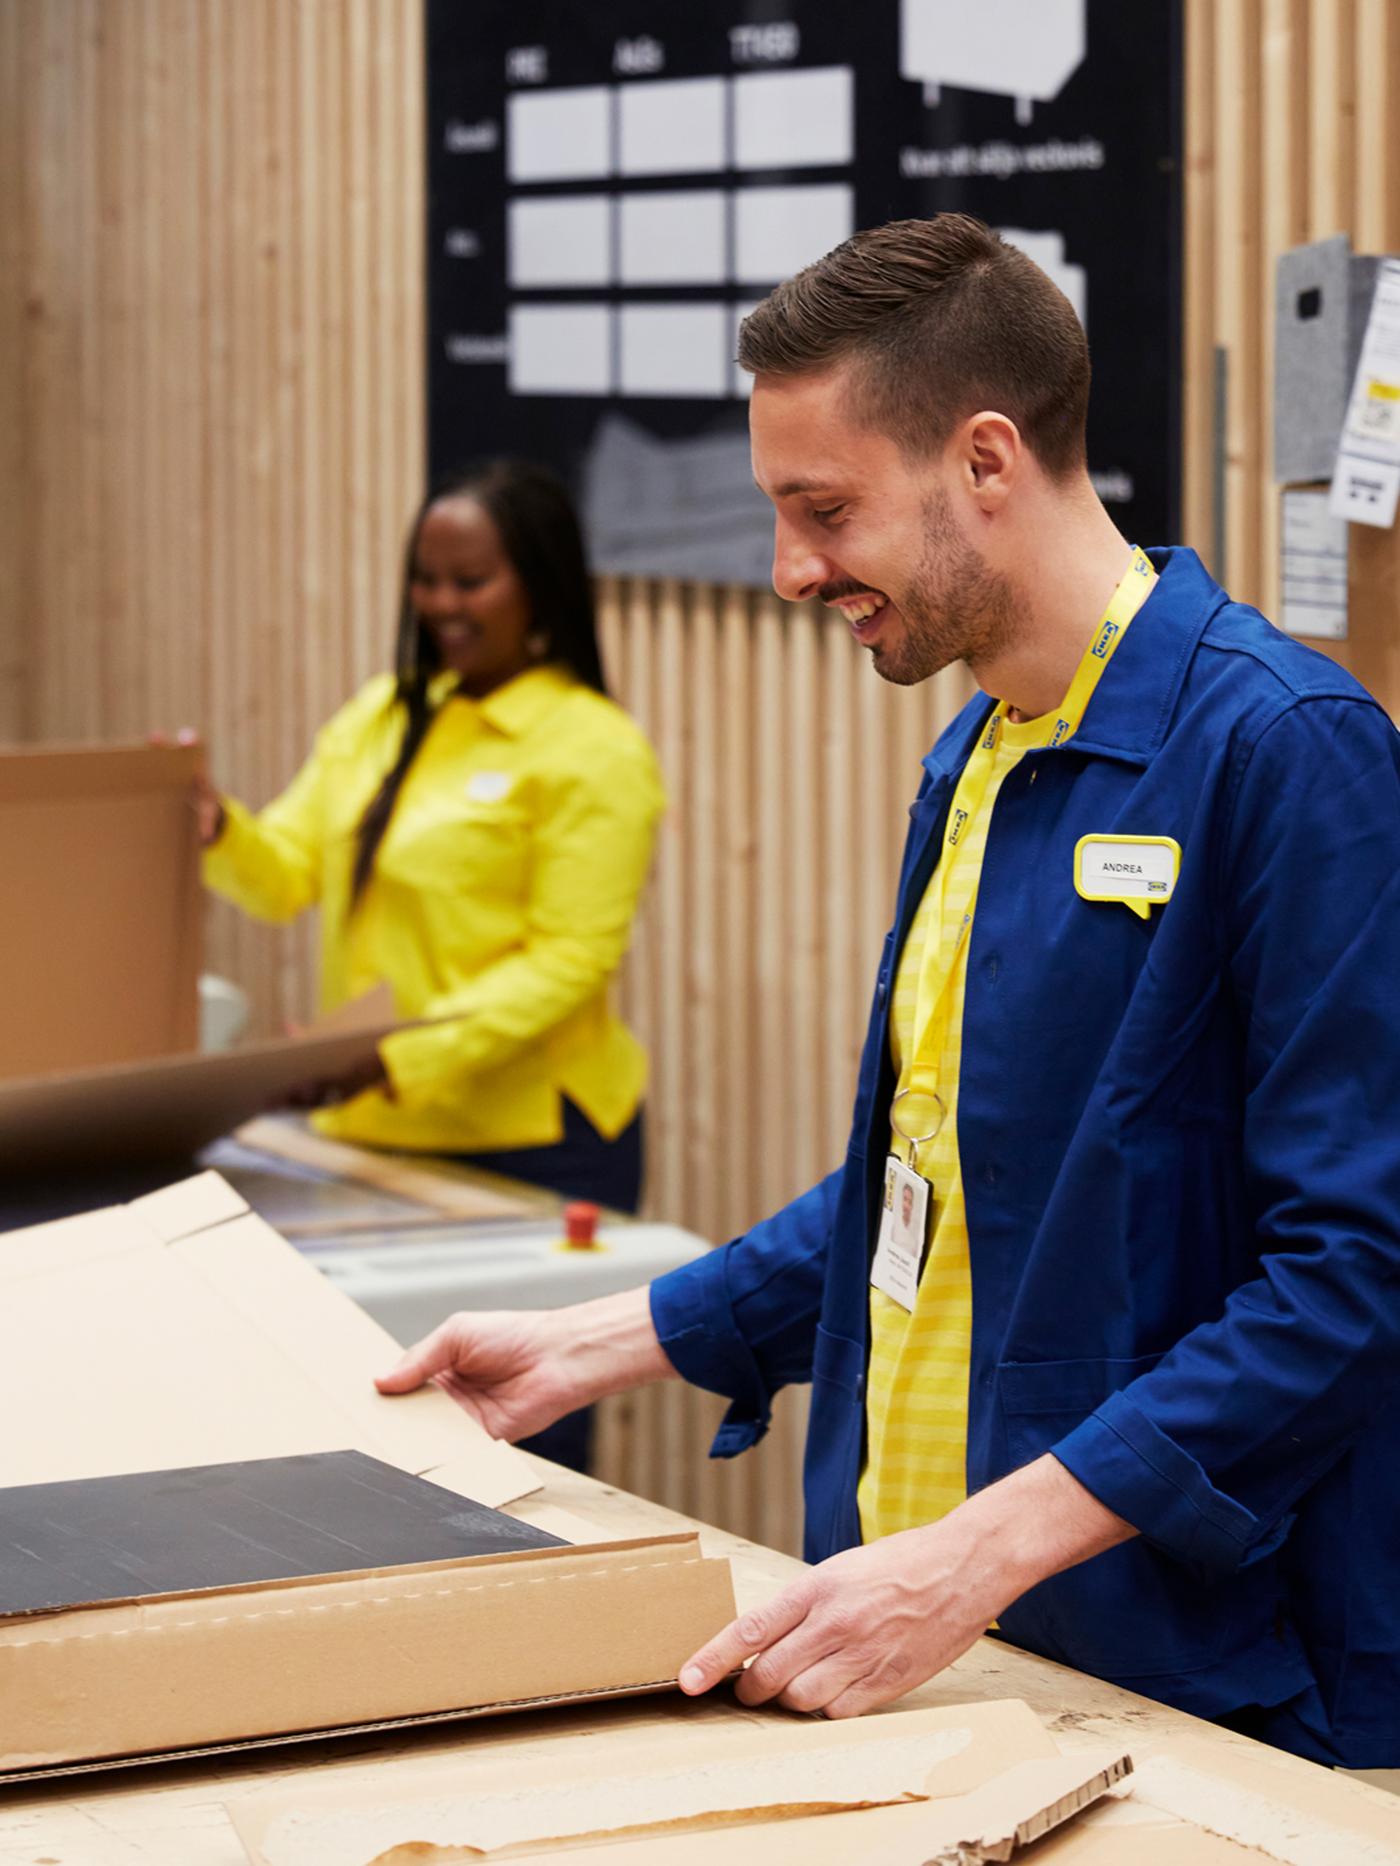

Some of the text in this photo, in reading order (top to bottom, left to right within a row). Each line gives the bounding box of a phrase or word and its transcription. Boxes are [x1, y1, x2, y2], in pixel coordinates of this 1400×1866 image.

[1094, 623, 1116, 657] IKEA
[1051, 721, 1067, 747] KEA
[950, 811, 966, 843] IKEA
[1102, 862, 1143, 874] ANDREA
